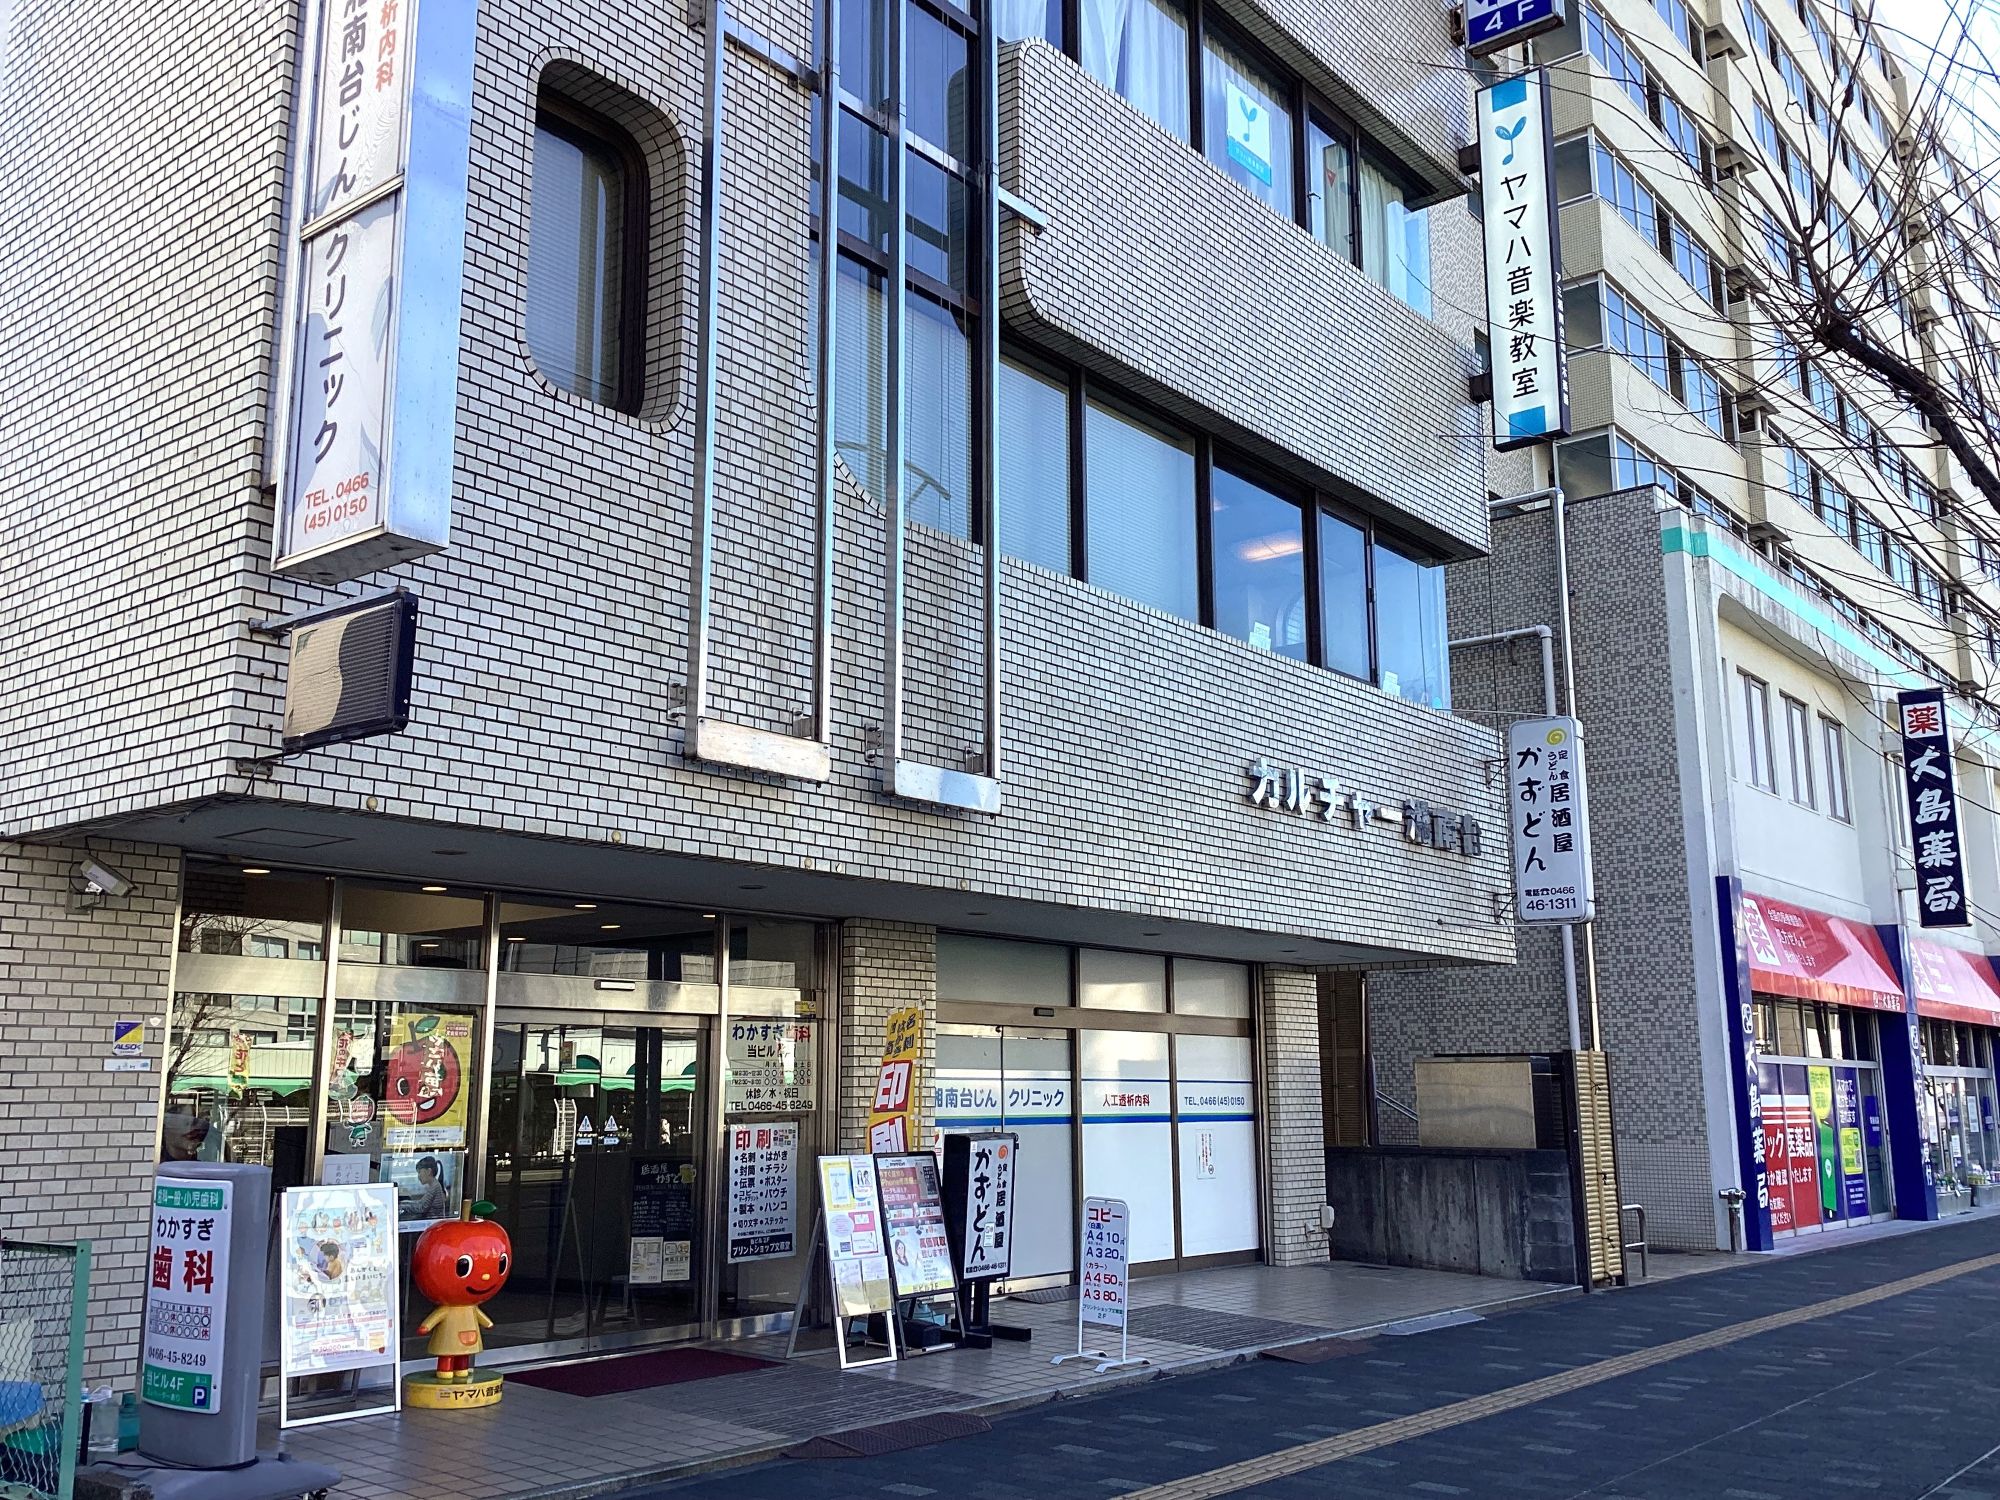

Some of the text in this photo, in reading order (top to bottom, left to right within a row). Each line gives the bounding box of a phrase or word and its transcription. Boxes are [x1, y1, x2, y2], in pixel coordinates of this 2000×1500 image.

[1499, 171, 1540, 399] ヤマハ音楽教室
[315, 233, 348, 465] クリニック
[1907, 705, 1940, 735] 薬
[1547, 751, 1558, 782] うどん
[1516, 746, 1547, 875] かずどん
[1550, 783, 1574, 854] 居酒屋
[1909, 745, 1960, 913] 大島薬局
[1526, 897, 1577, 911] 46-1311
[1550, 886, 1575, 896] 0466
[1008, 1089, 1065, 1108] クリニック
[1102, 1094, 1150, 1107] 人工透析内科
[1746, 1046, 1769, 1209] 大島薬局
[766, 1150, 788, 1161] はがき
[1763, 1126, 1814, 1158] ック医薬品
[764, 1175, 788, 1187] ポスター
[765, 1163, 788, 1174] チラシ
[764, 1201, 788, 1212] ハンコ
[970, 1147, 993, 1264] かずどん
[1088, 1207, 1123, 1223] コピー
[156, 1214, 215, 1241] わかすぎ
[764, 1216, 789, 1225] ステッカー
[152, 1245, 214, 1294] 歯科
[148, 1346, 206, 1367] 0466-45-8249
